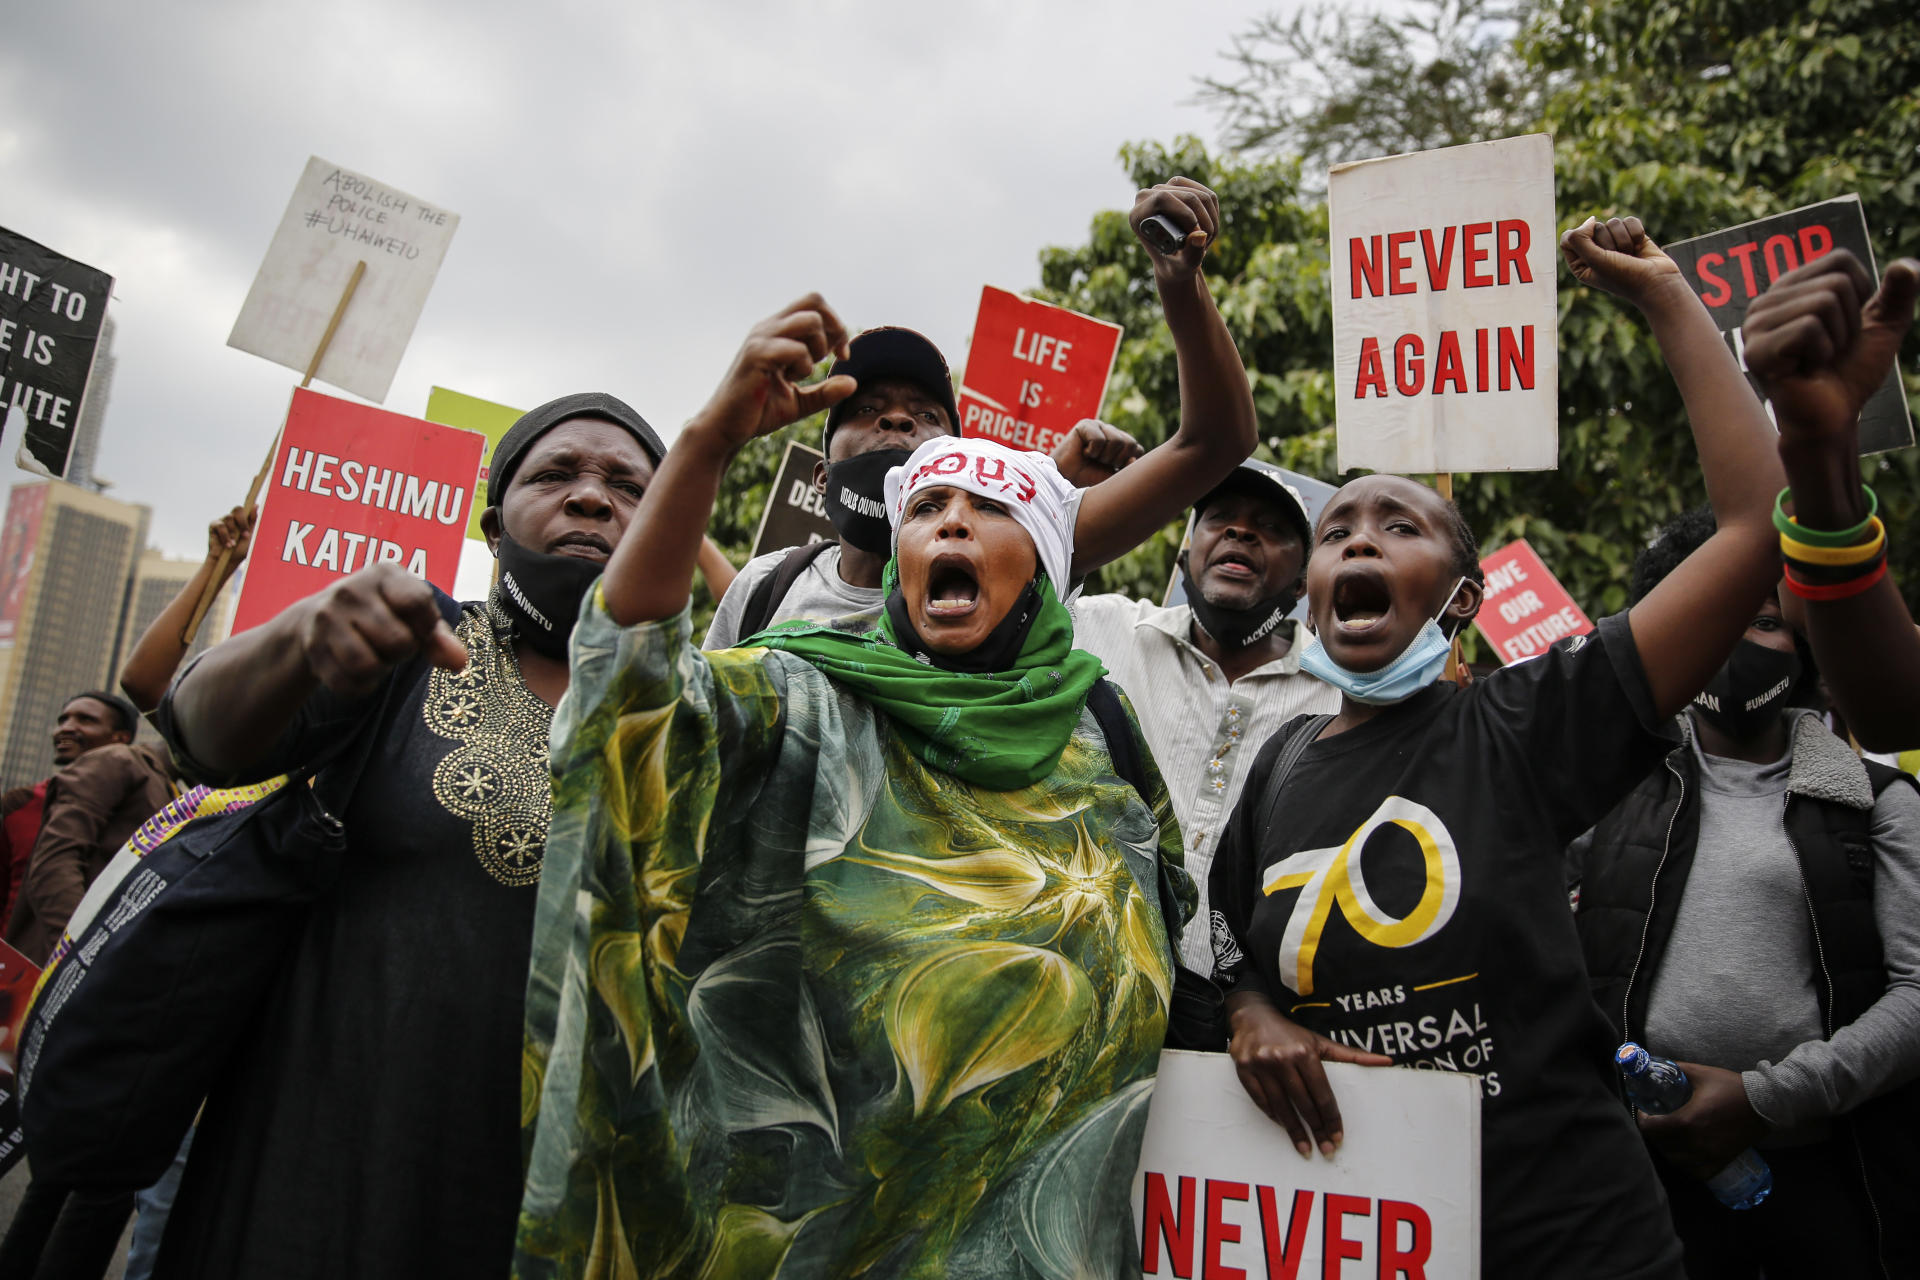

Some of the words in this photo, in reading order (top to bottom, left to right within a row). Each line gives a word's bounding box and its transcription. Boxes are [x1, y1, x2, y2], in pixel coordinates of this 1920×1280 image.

[322, 169, 409, 215] ABOLISH
[416, 205, 449, 227] THE
[326, 193, 389, 225] POLICE
[304, 209, 420, 260] #UHAIWETU
[1349, 218, 1534, 300] NEVER
[50, 283, 87, 322] TO
[22, 329, 56, 367] IS
[1012, 327, 1073, 373] LIFE
[1354, 324, 1535, 400] AGAIN
[1019, 379, 1044, 408] IS
[280, 446, 465, 526] HESHIMU
[840, 486, 859, 511] VITALIS
[503, 570, 553, 632] #UHAIWETU
[1498, 589, 1545, 625] OUR
[1503, 605, 1583, 660] FUTURE
[1744, 676, 1790, 712] #UHAIWETU
[1262, 795, 1461, 997] 70
[1336, 984, 1406, 1013] YEARS
[1463, 1038, 1494, 1068] OF
[1140, 1171, 1432, 1280] NEVER
